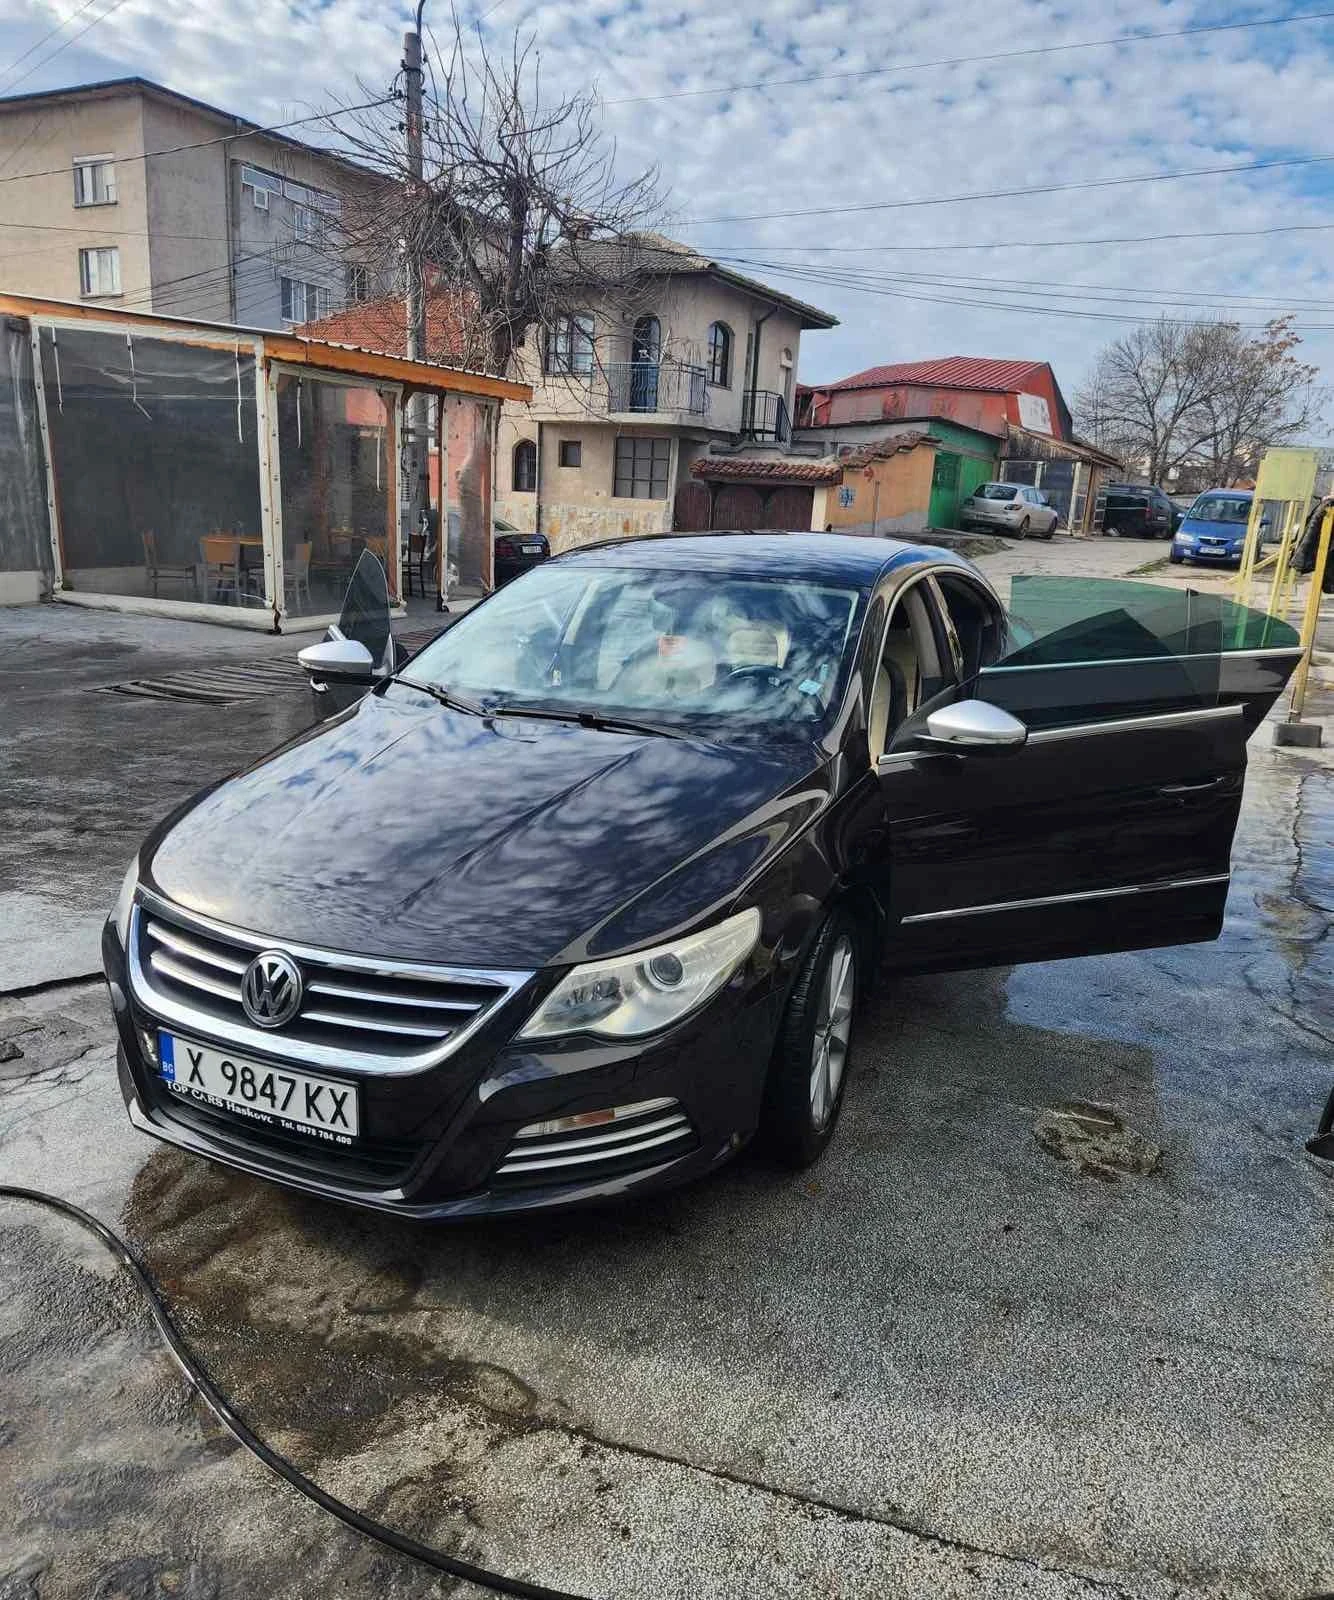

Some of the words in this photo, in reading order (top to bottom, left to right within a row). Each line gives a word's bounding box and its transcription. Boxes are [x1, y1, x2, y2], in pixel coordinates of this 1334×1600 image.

[162, 1061, 174, 1074] BG
[186, 1047, 205, 1088] X
[220, 1060, 297, 1112] 9847
[304, 1081, 349, 1128] KX
[167, 1080, 189, 1094] TOP
[191, 1088, 224, 1108] CARS
[281, 1119, 295, 1130] Tel.
